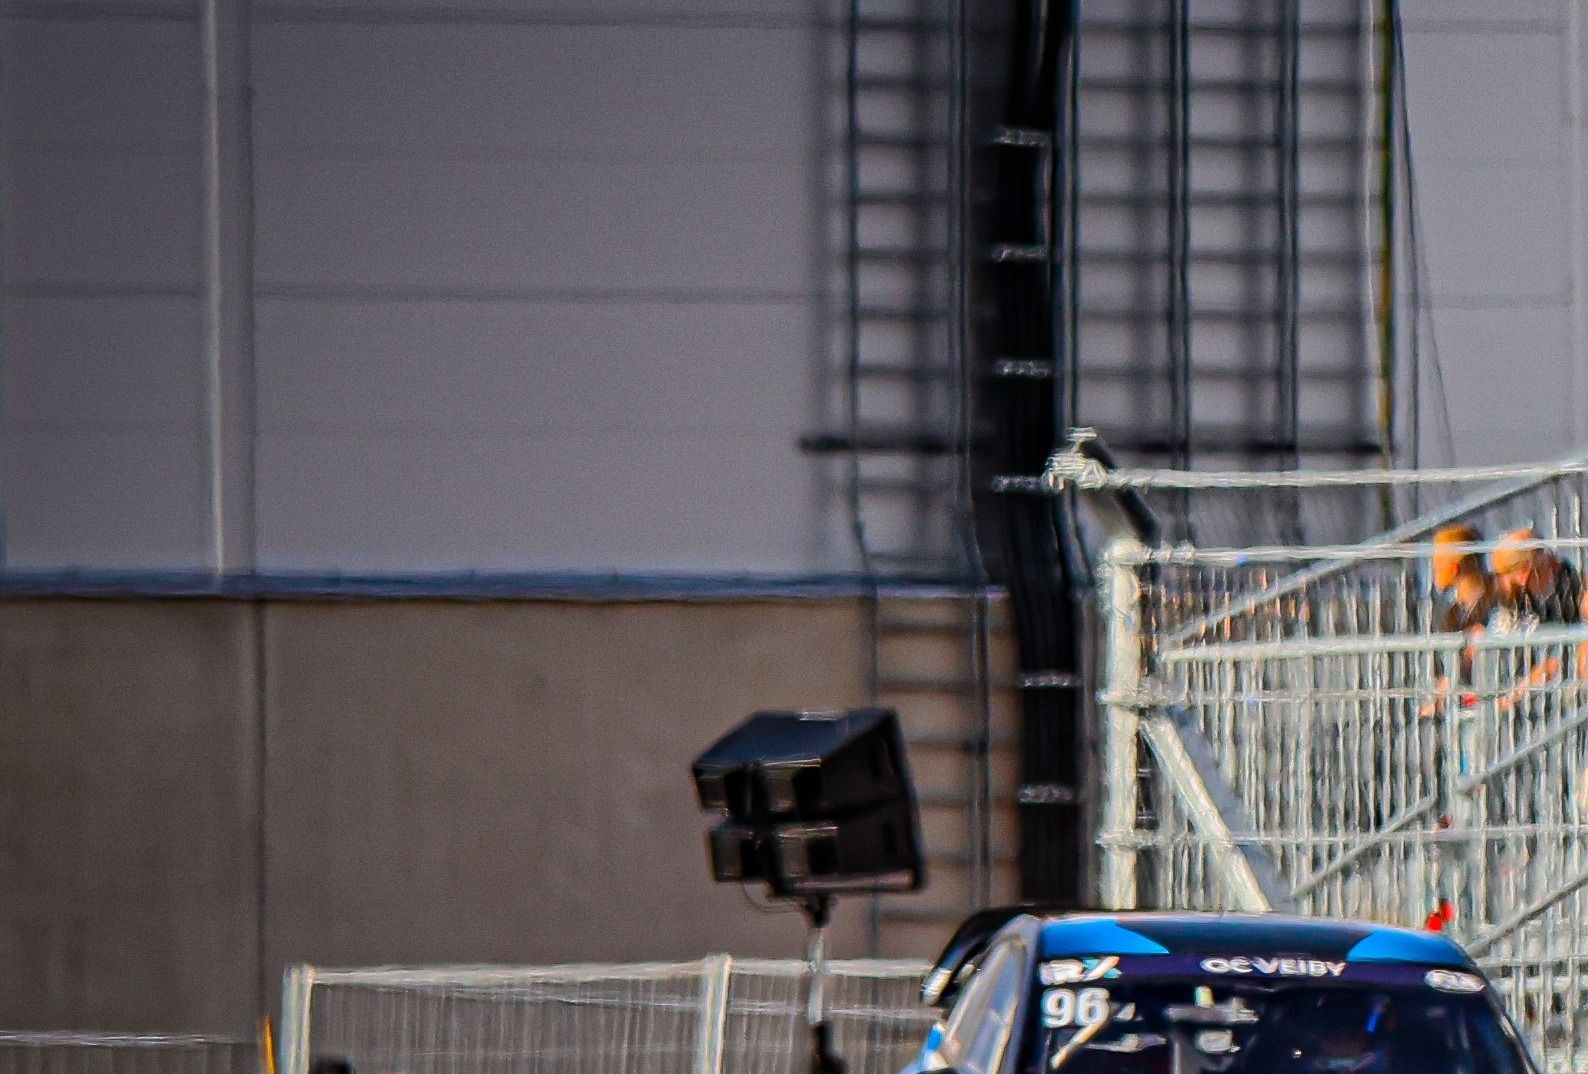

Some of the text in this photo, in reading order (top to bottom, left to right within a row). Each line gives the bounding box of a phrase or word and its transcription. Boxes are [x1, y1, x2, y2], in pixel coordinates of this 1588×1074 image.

[1200, 956, 1347, 977] OC VEIBY
[1042, 987, 1110, 1028] 96
